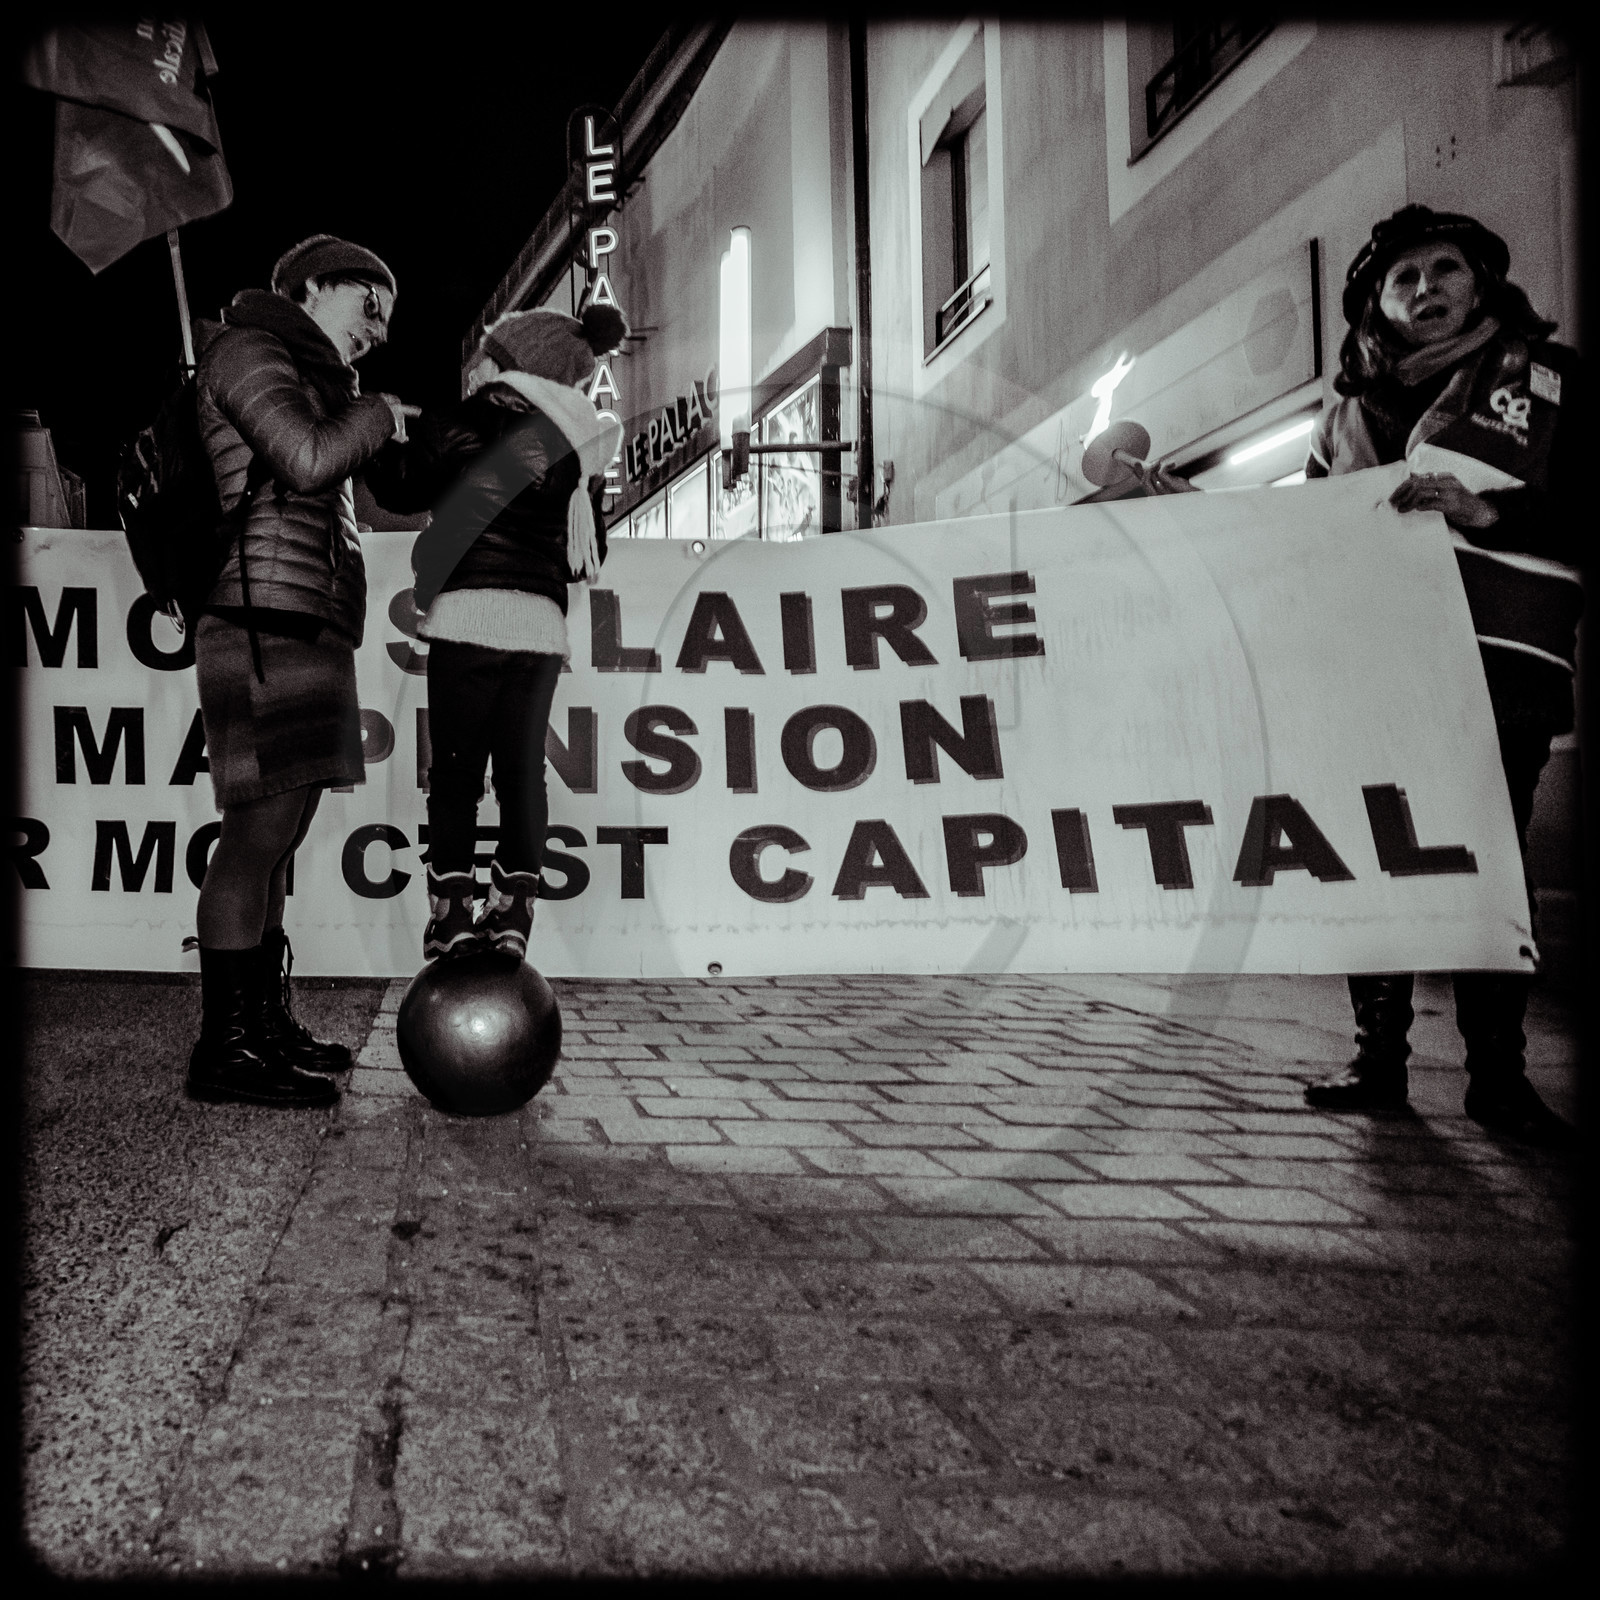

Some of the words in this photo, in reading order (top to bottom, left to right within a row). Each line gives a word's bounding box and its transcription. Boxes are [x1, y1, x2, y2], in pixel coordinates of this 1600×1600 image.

[584, 116, 616, 202] LE
[625, 433, 646, 483] LE
[648, 368, 719, 463] PALAC
[729, 783, 1479, 904] CAPITAL
